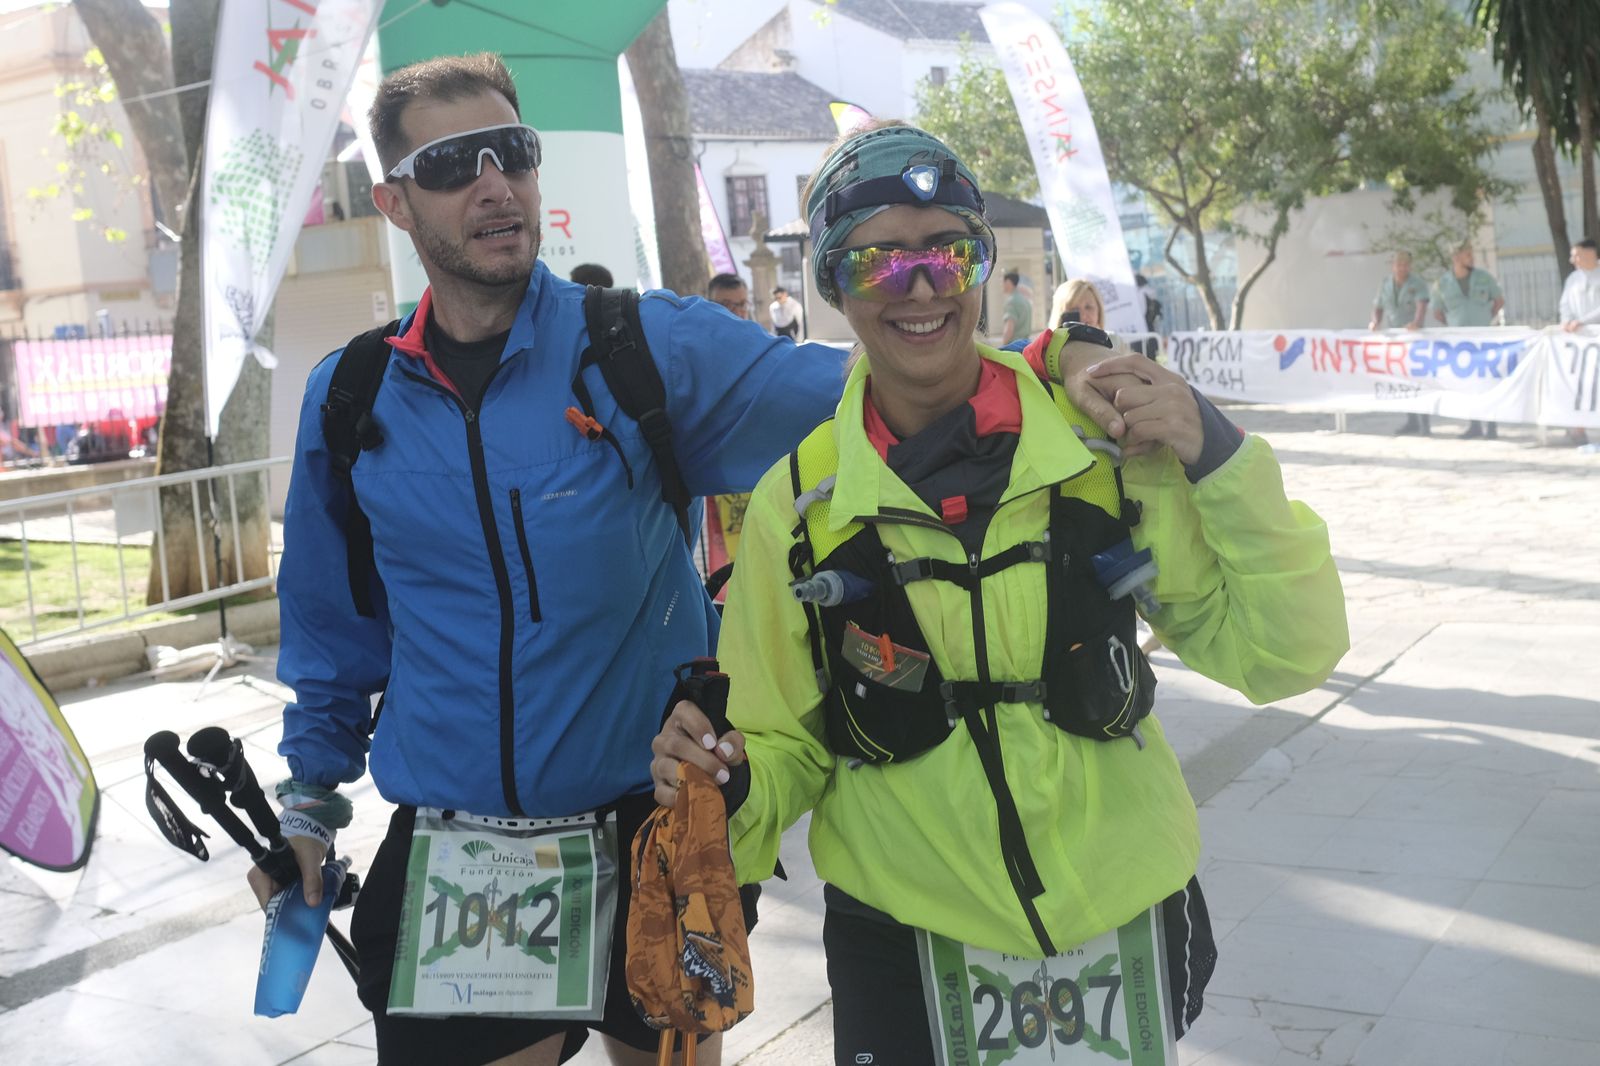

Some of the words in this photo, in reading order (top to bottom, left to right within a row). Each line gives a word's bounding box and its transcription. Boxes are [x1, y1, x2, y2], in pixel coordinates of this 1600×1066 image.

[1311, 337, 1526, 378] INTERSPORT
[460, 866, 534, 878] Fundación
[491, 852, 534, 867] Unicaja
[425, 891, 560, 948] 1012
[568, 906, 583, 959] EDICIÓN
[1131, 956, 1145, 988] XXIII
[973, 975, 1121, 1050] 2697
[1134, 992, 1152, 1051] EDICIÓN
